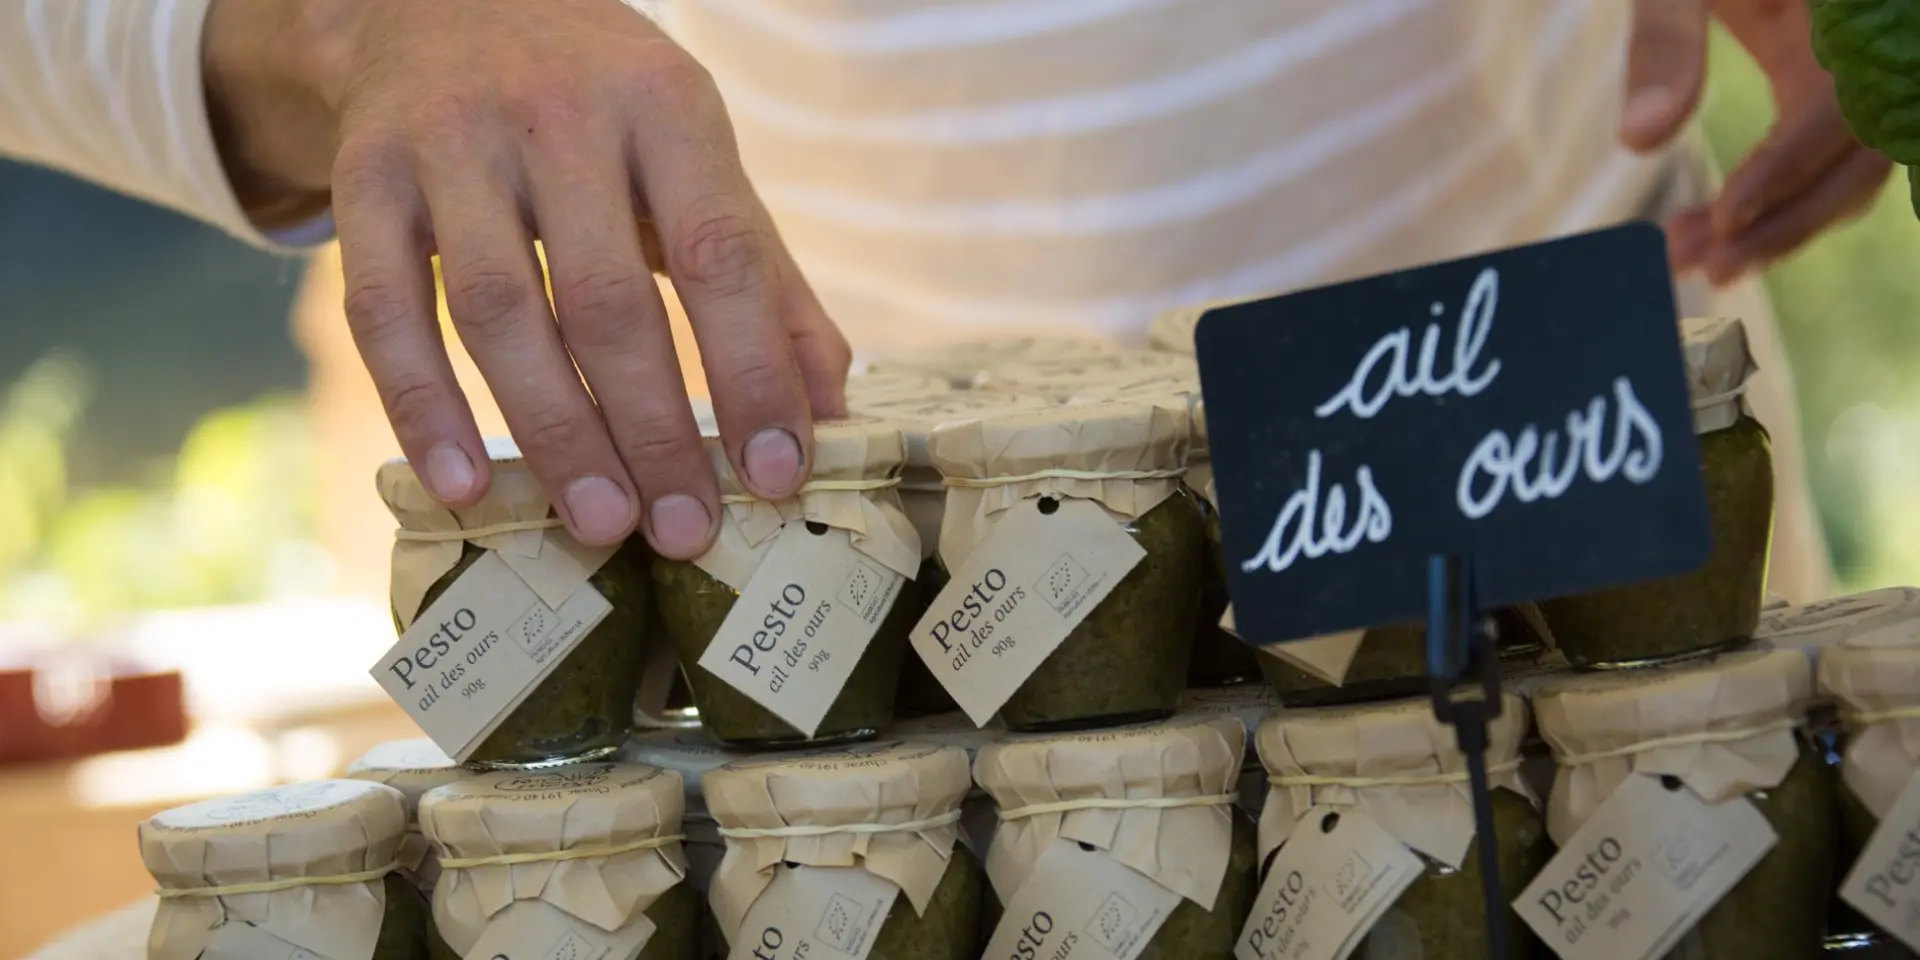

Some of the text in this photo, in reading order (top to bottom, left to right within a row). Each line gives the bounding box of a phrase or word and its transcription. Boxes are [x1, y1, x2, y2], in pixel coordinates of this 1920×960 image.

[1315, 268, 1501, 418] ail
[1242, 377, 1663, 572] des ours
[389, 608, 476, 691] Pesto
[729, 584, 805, 676] Pesto
[769, 600, 832, 693] ail des ours
[929, 568, 1006, 653] Pesto
[952, 586, 1026, 671] ail des ours
[992, 636, 1016, 657] 90g
[418, 685, 440, 712] ail
[441, 663, 465, 690] des
[466, 630, 499, 665] ours
[461, 678, 486, 700] 90g
[809, 649, 831, 673] 90g
[1249, 870, 1303, 958] Pesto
[1538, 836, 1623, 927] Pesto
